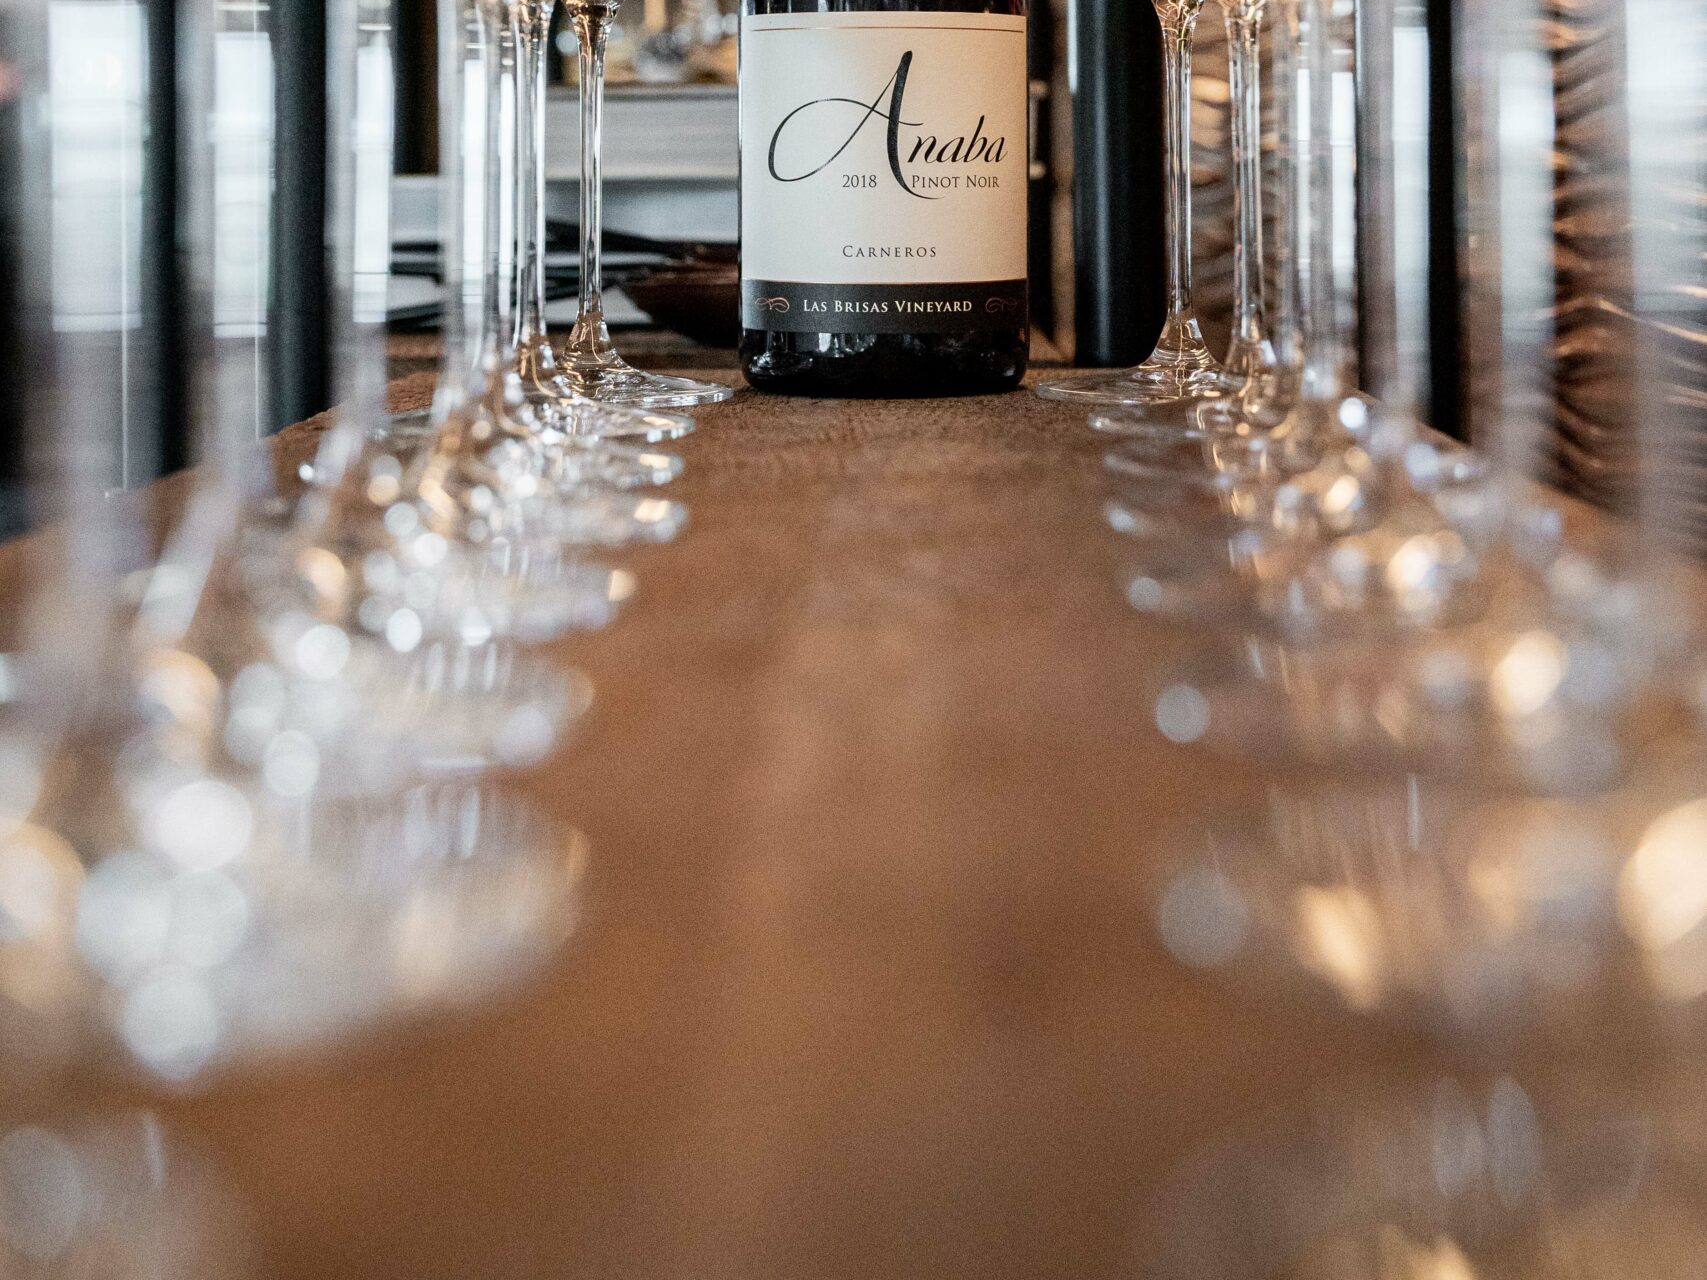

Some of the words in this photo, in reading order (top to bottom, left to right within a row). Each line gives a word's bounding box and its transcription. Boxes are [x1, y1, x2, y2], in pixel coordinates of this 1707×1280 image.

[768, 50, 1008, 199] Anaba
[842, 174, 878, 189] 2018
[911, 174, 961, 189] PINOT
[966, 174, 1001, 189] NOIR
[842, 244, 938, 259] CARNEROS
[803, 298, 828, 313] LAS
[834, 299, 889, 314] BRISAS
[895, 299, 973, 314] VINEYARD
